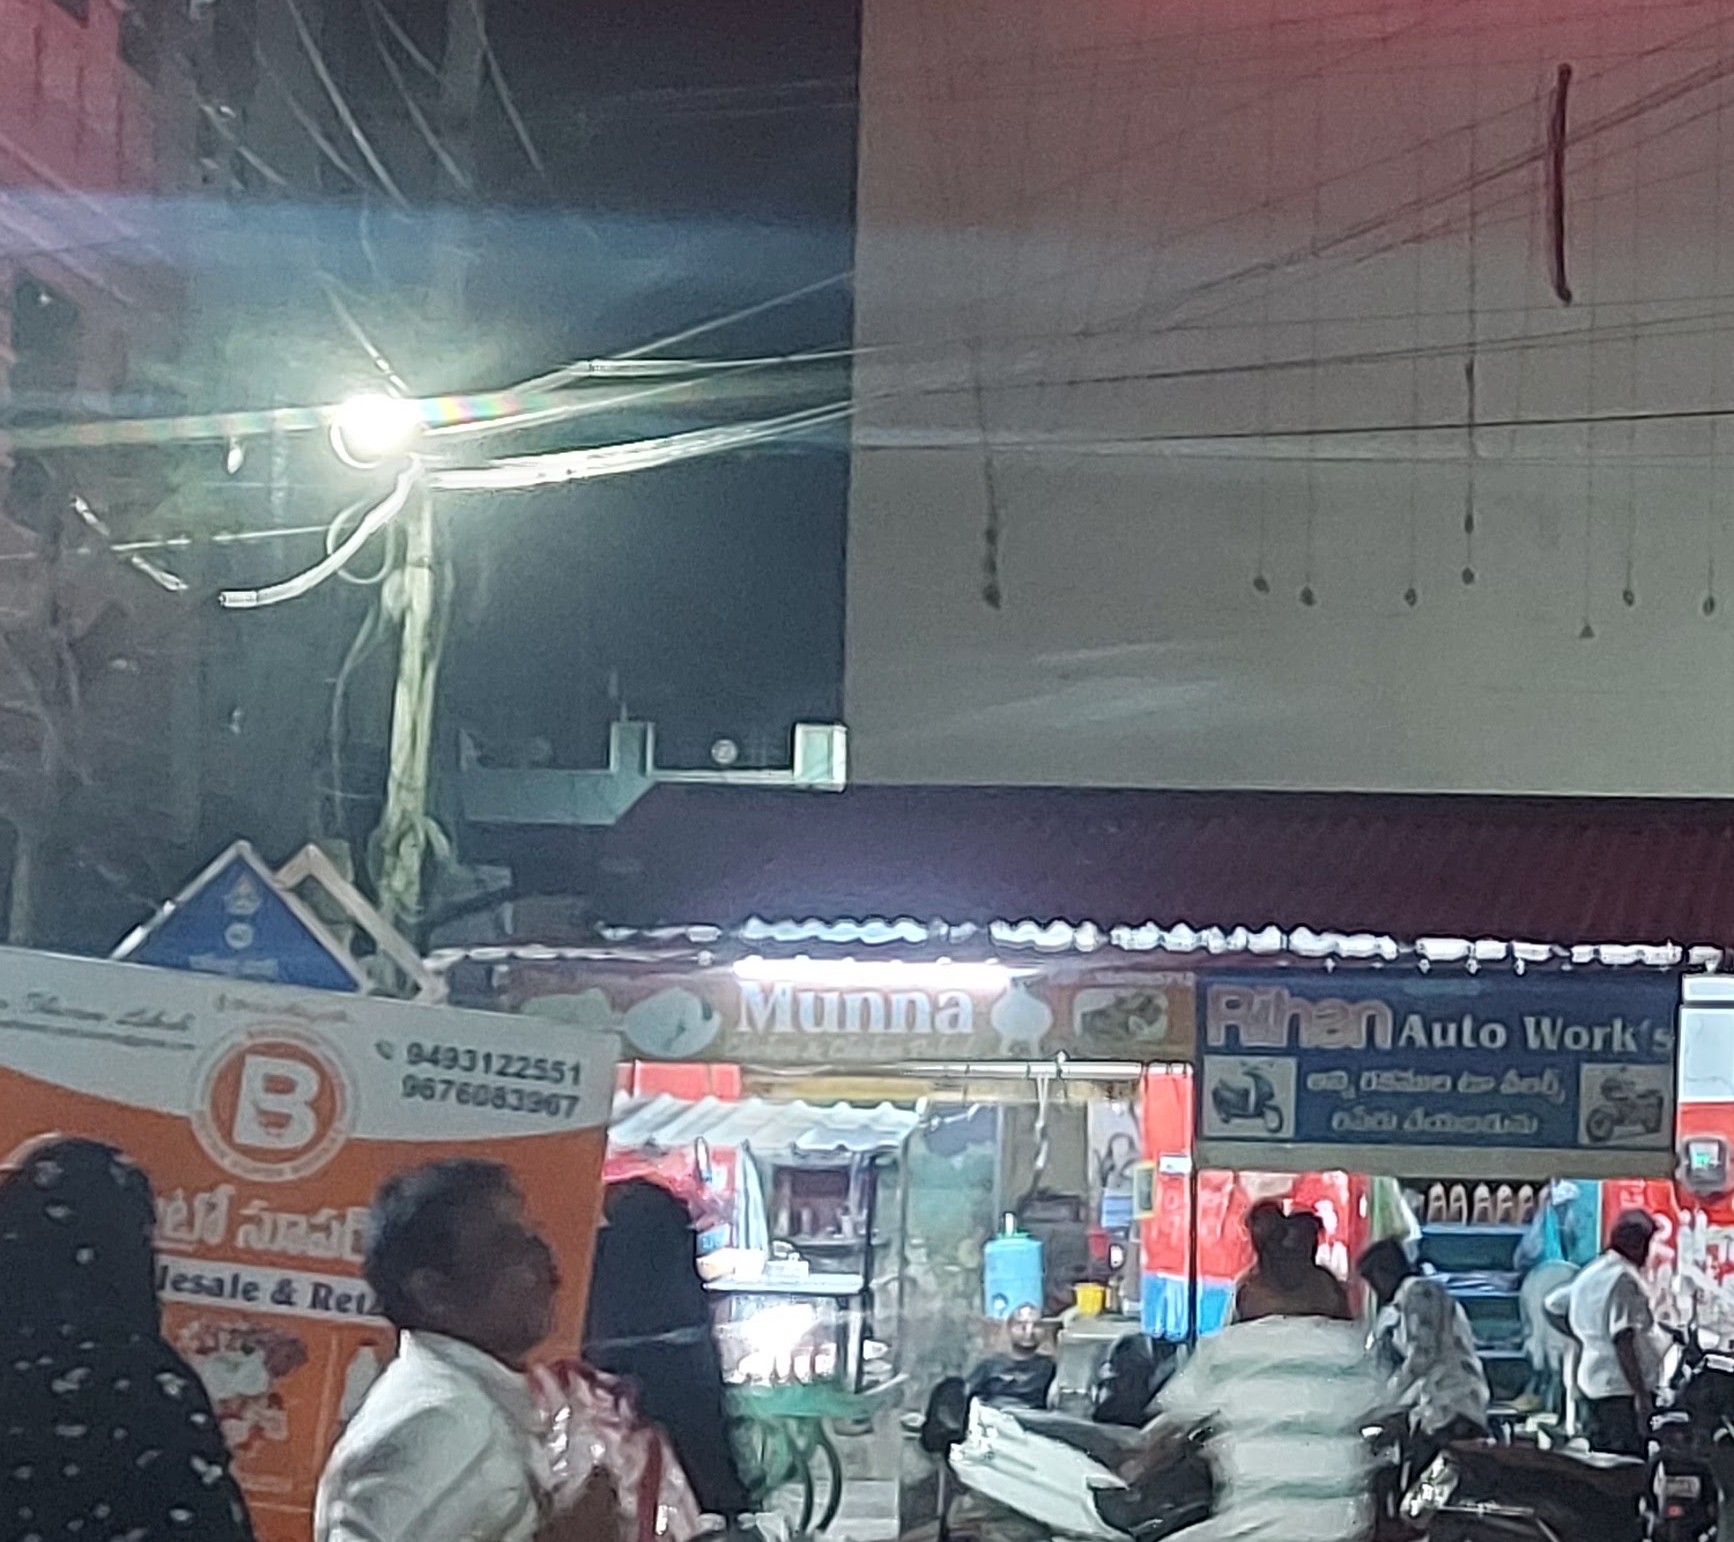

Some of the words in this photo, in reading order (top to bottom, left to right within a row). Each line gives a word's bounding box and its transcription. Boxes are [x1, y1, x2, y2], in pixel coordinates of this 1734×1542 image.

[736, 980, 975, 1035] Munna
[1206, 984, 1393, 1049] Rihan
[1399, 1014, 1506, 1050] Auto
[1523, 1015, 1674, 1053] Work's
[232, 1054, 321, 1150] B
[157, 1264, 259, 1302] lesale
[270, 1278, 298, 1306] &
